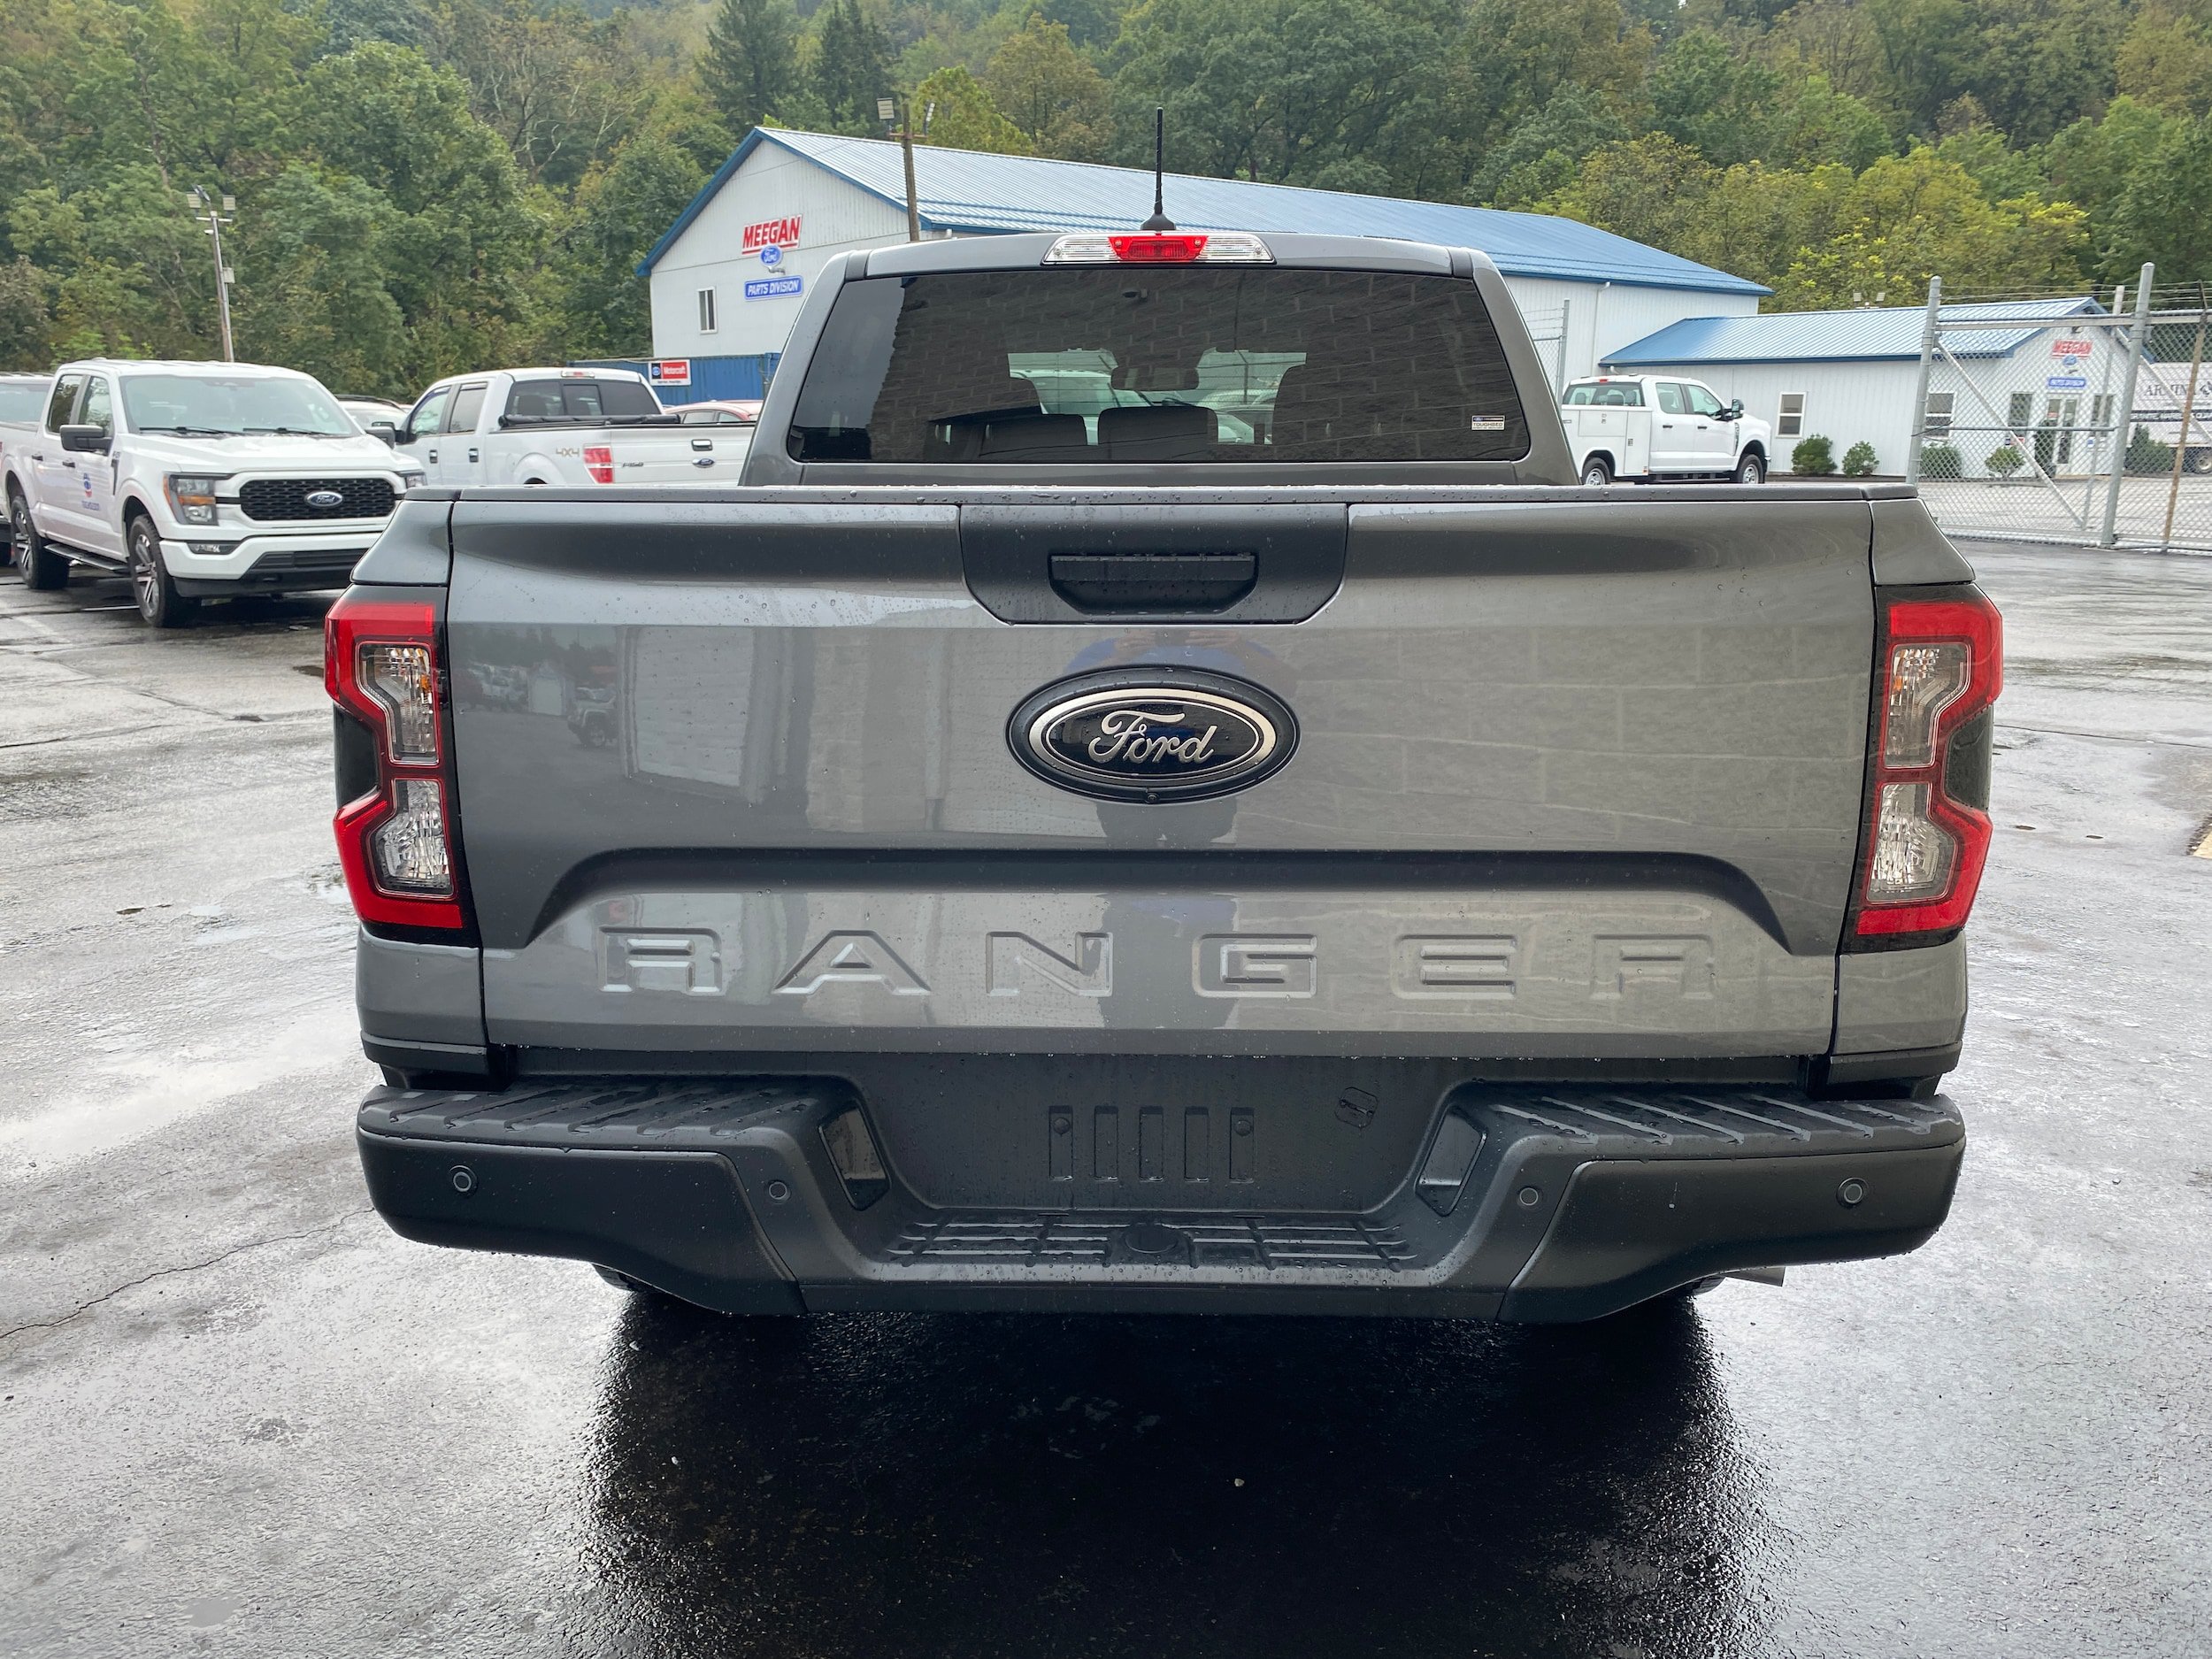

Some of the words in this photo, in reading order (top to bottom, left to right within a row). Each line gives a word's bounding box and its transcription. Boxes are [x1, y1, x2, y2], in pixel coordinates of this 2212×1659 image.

[743, 217, 801, 248] MEEGAN
[748, 282, 769, 296] PARTS
[769, 279, 800, 294] DIVISION
[1087, 710, 1218, 764] Ford
[597, 925, 1715, 1002] RANGER
